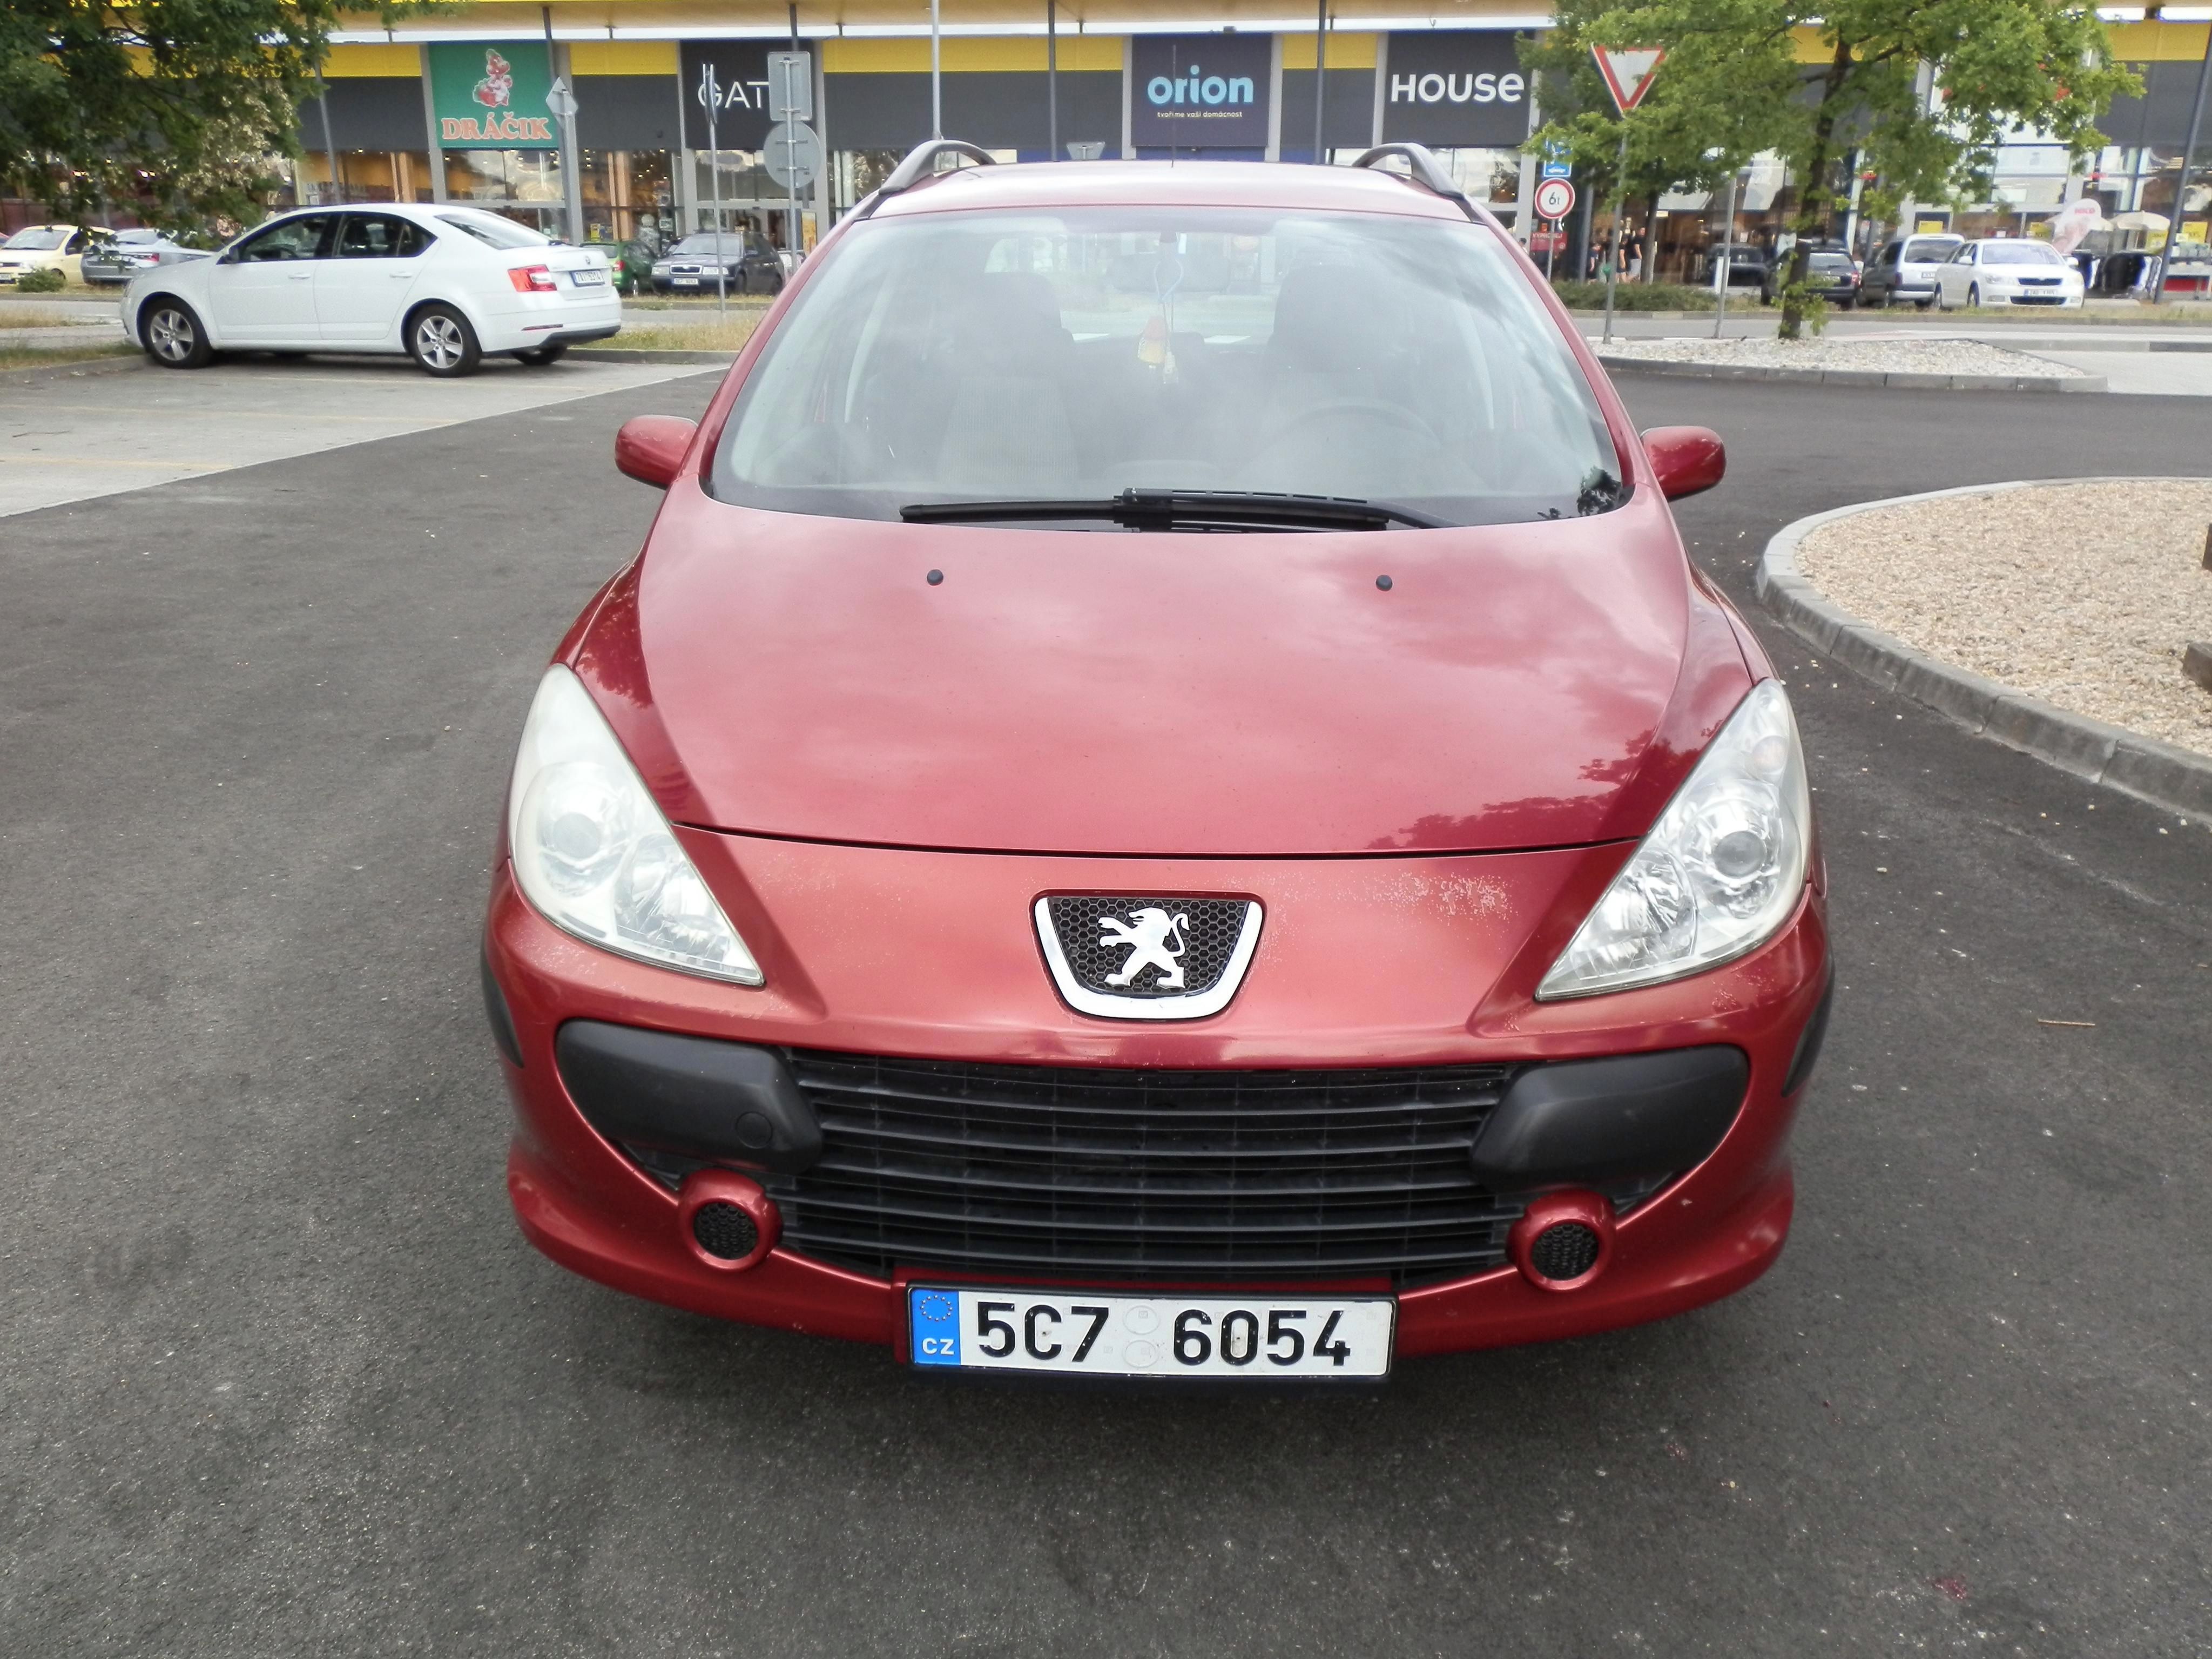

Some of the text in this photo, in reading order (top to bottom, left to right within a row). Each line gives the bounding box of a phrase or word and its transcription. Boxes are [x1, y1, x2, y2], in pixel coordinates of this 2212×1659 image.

[698, 81, 769, 109] GAT
[1148, 65, 1253, 104] orion
[441, 111, 552, 139] DRÁČIK
[922, 1338, 955, 1355] CZ
[977, 1301, 1351, 1366] 5C7 6054
